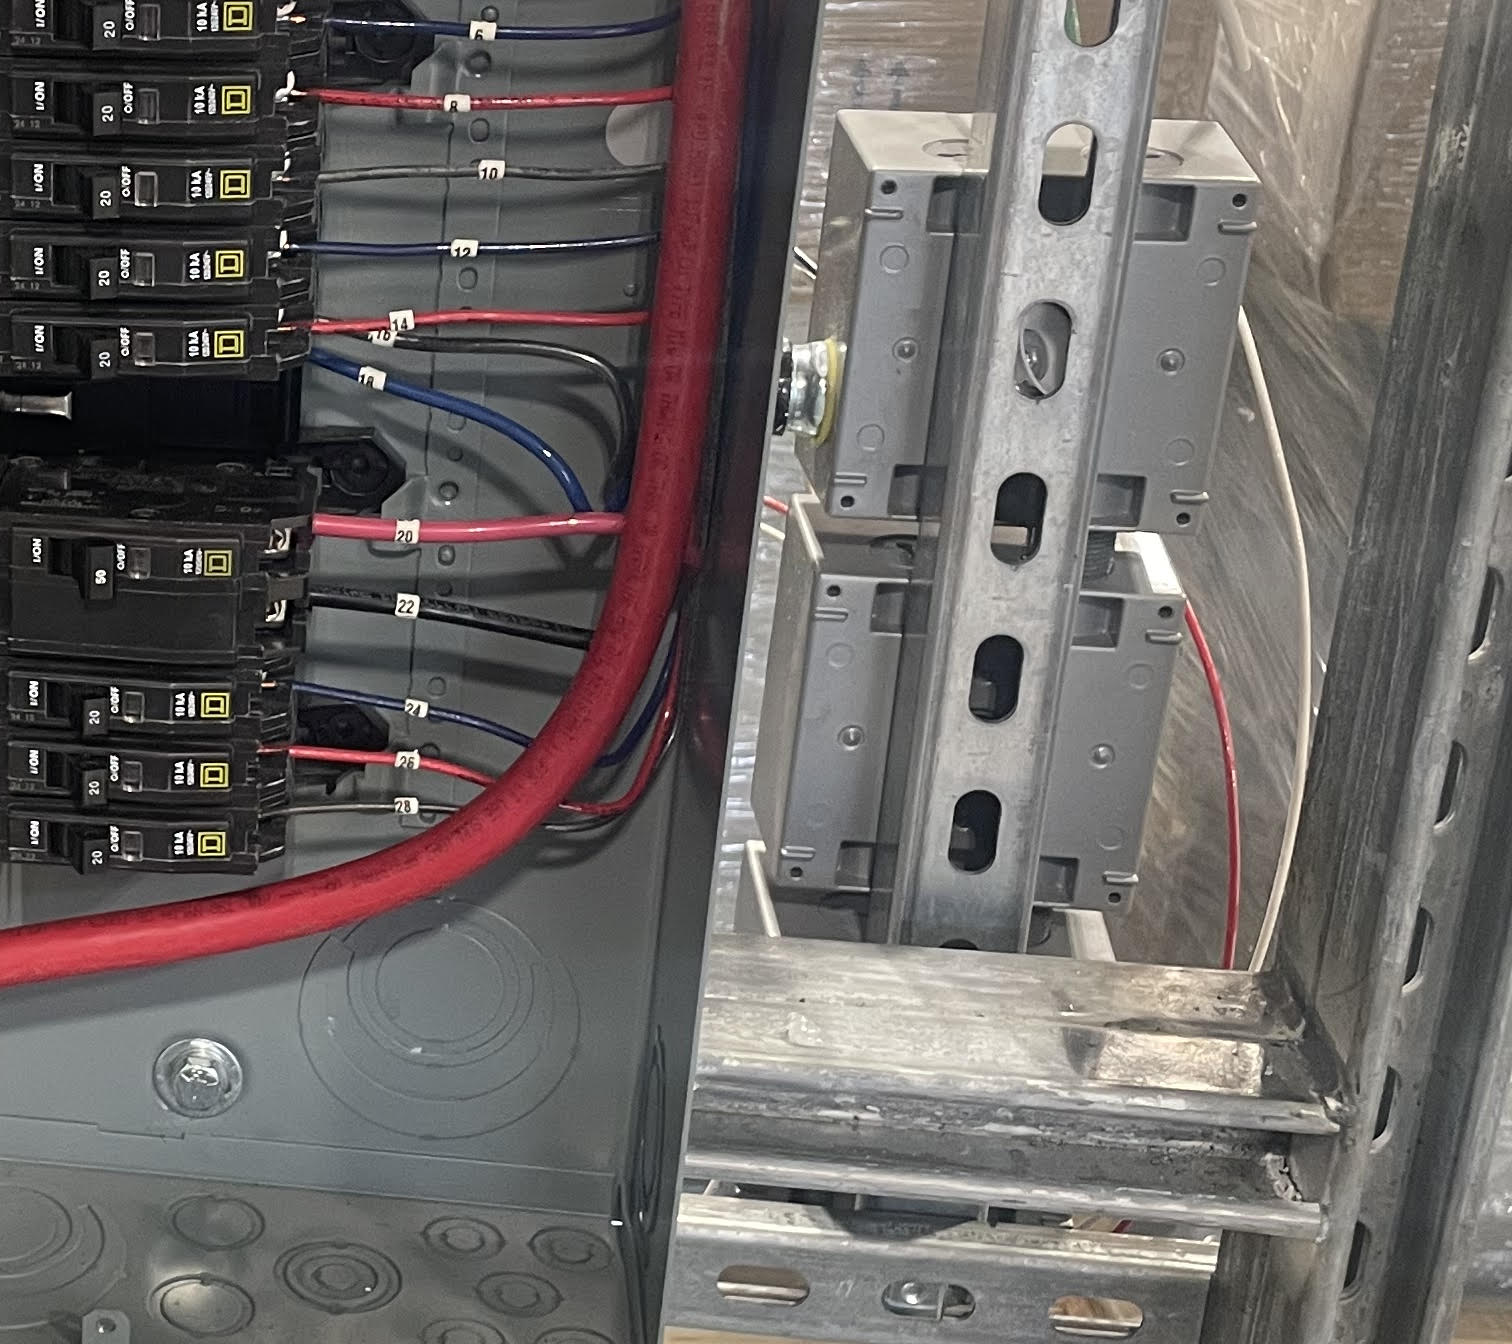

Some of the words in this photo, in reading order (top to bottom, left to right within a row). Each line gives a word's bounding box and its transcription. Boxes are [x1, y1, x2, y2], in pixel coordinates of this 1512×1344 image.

[103, 21, 115, 38] 20
[102, 106, 113, 122] 20
[481, 167, 497, 179] 10
[100, 191, 111, 206] 20
[455, 247, 471, 257] 12
[98, 271, 110, 286] 20
[392, 319, 408, 331] 14
[99, 352, 110, 367] 20
[398, 530, 413, 543] 20
[398, 600, 414, 613] 22
[89, 711, 100, 724] 20
[89, 781, 99, 795] 20
[395, 800, 411, 813] 28
[92, 851, 102, 864] 20
